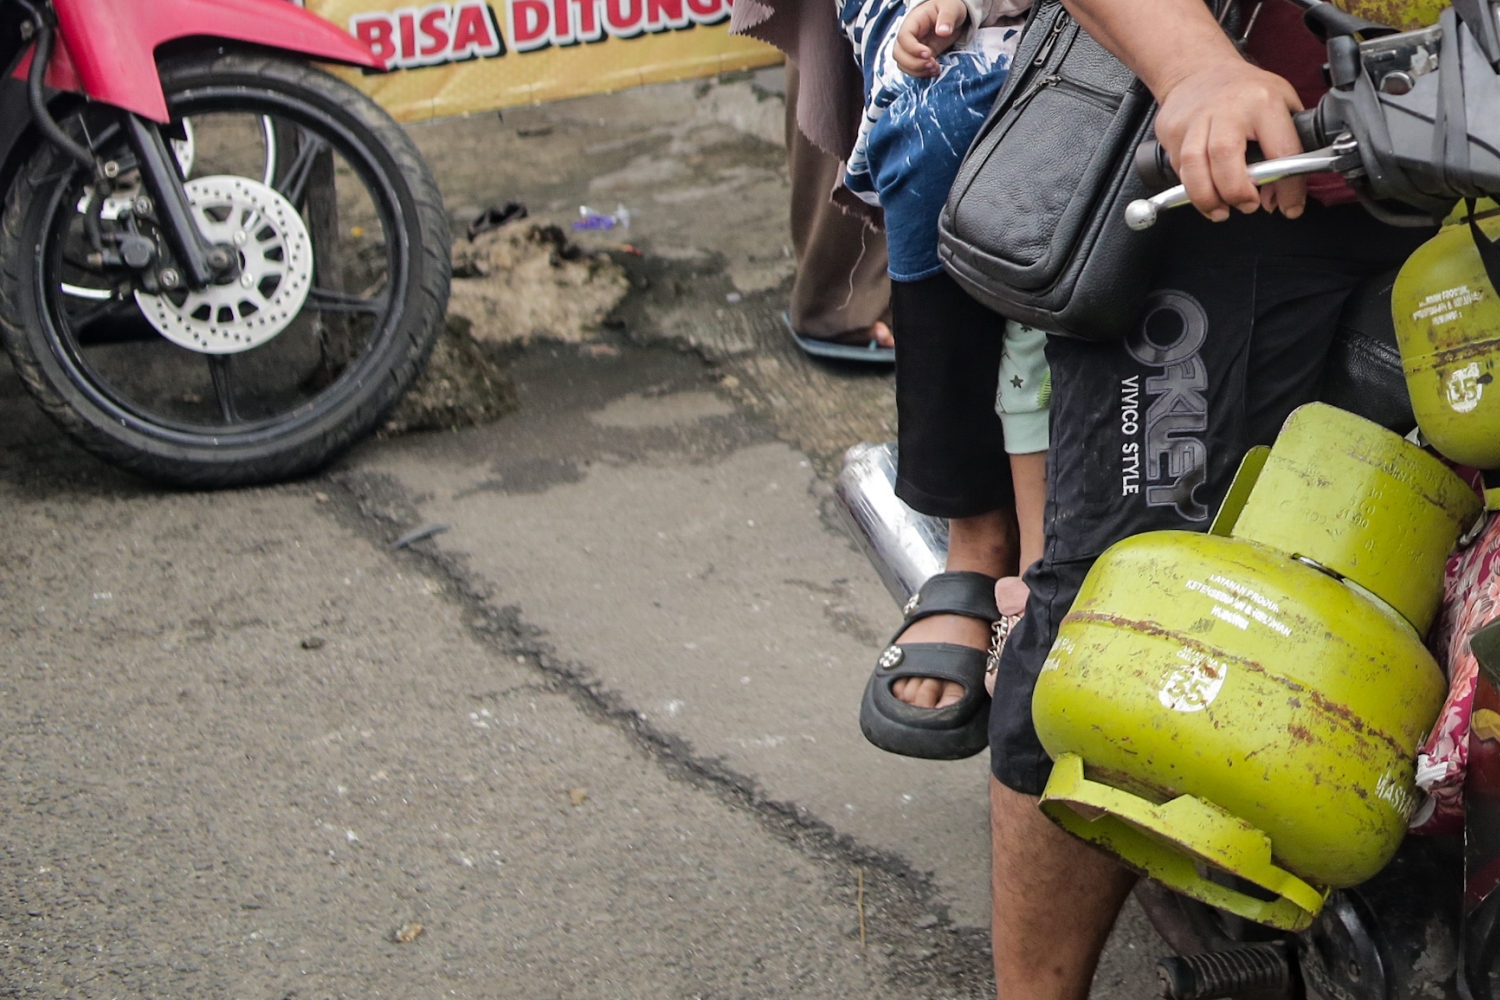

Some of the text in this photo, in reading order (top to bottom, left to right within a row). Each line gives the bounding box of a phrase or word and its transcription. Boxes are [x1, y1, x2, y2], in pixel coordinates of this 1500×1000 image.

[353, 3, 495, 65] BISA
[1120, 375, 1140, 497] VIVICO STYLE
